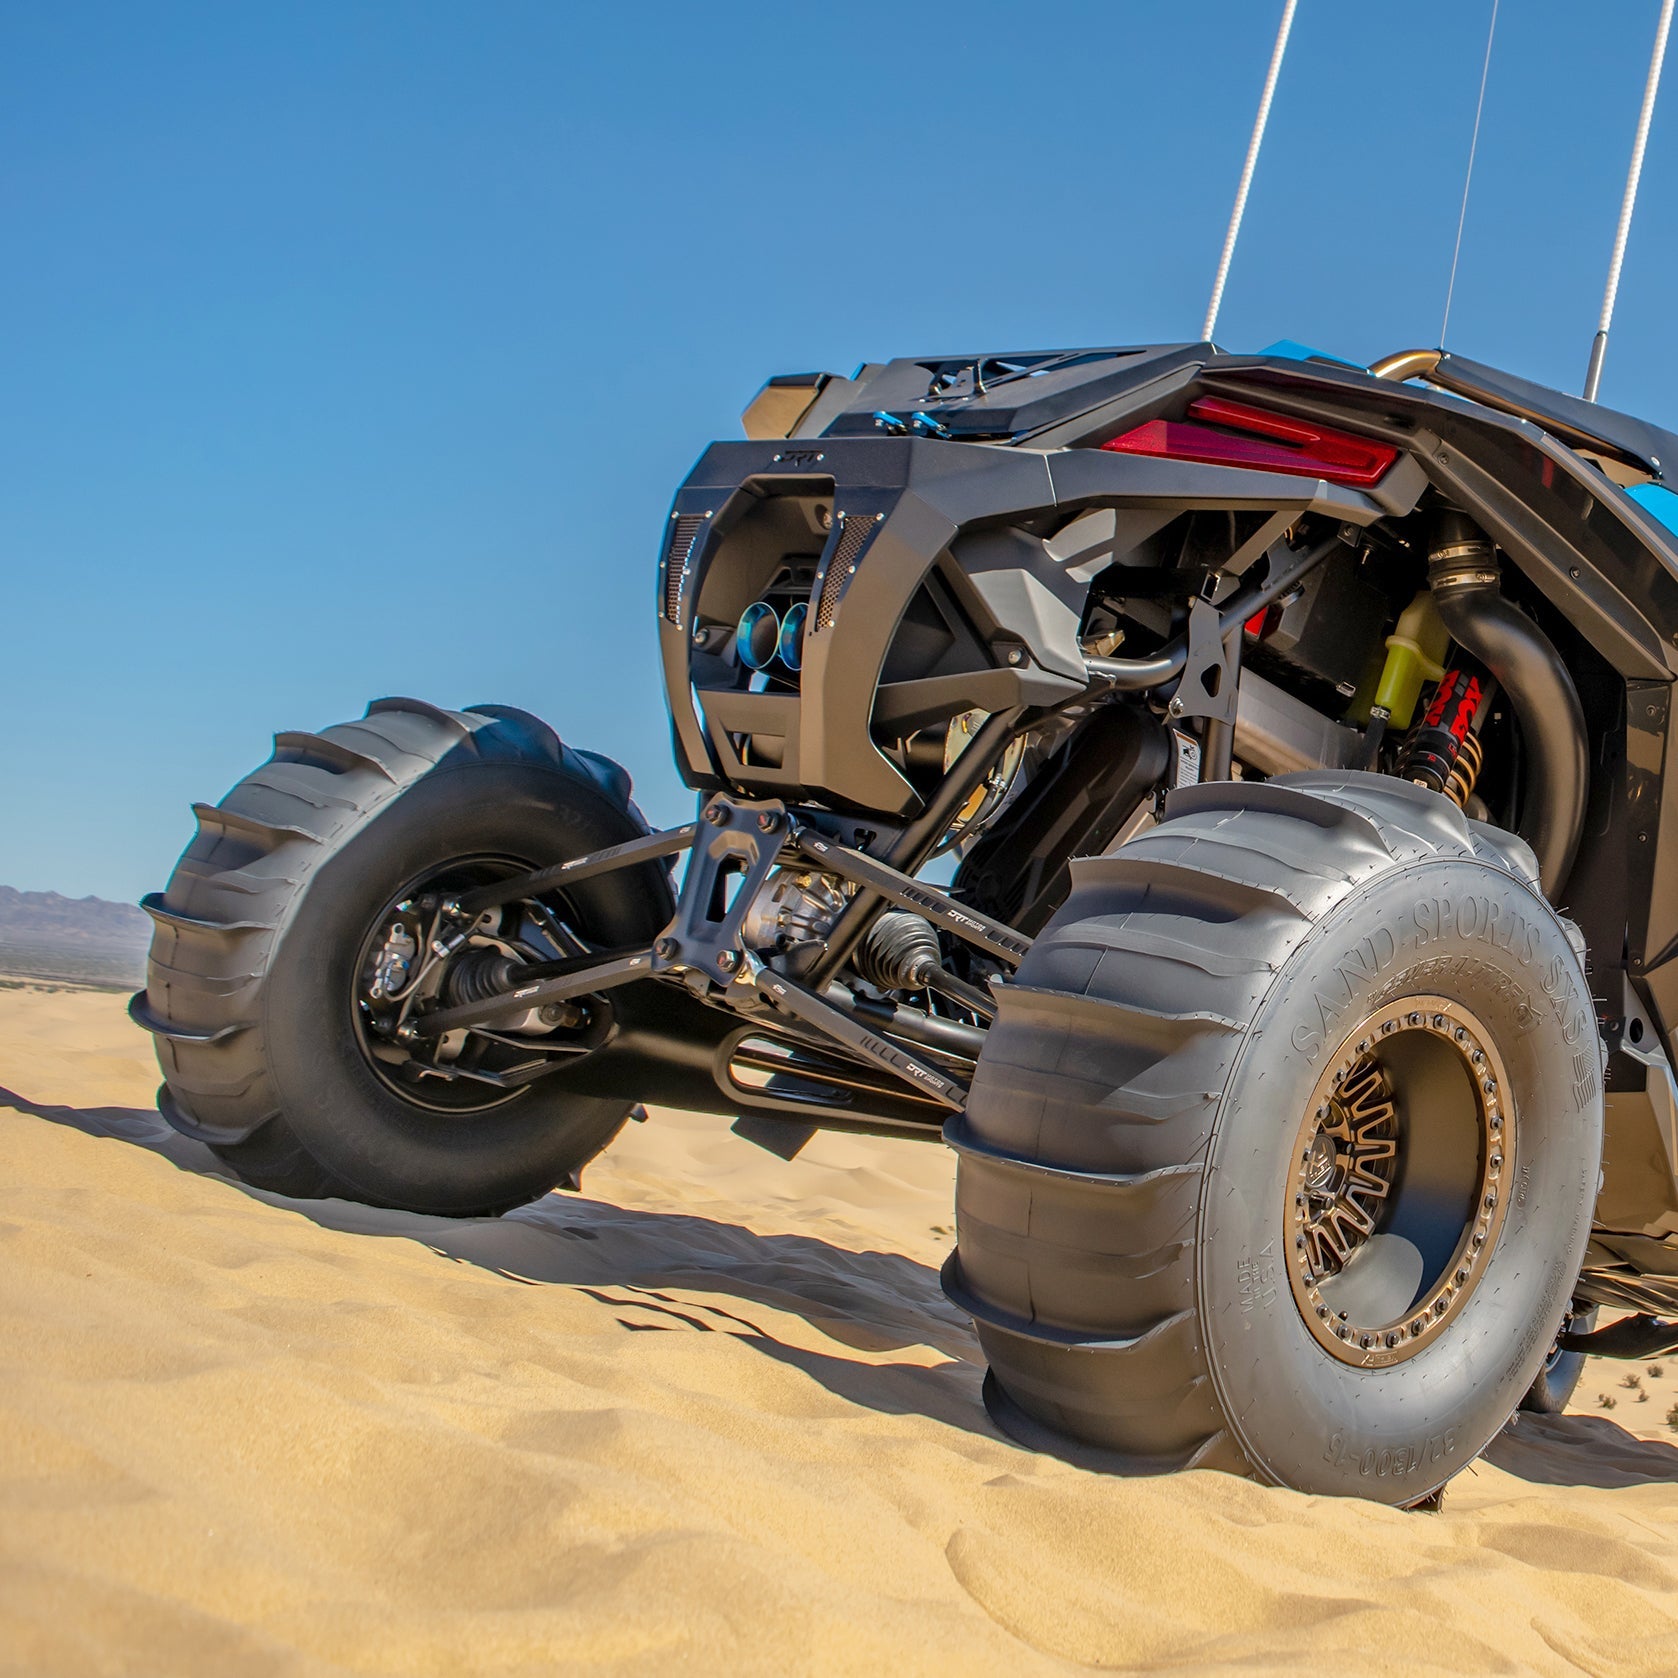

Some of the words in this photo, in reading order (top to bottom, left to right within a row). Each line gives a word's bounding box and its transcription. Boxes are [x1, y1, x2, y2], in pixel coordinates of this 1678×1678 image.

[1449, 676, 1483, 745] FOX
[947, 909, 969, 922] DRT
[1291, 926, 1396, 1066] SAND
[1413, 895, 1542, 969] SPORTS
[1540, 953, 1588, 1046] SXS
[906, 1062, 928, 1077] DRT
[1237, 1256, 1254, 1314] MADE
